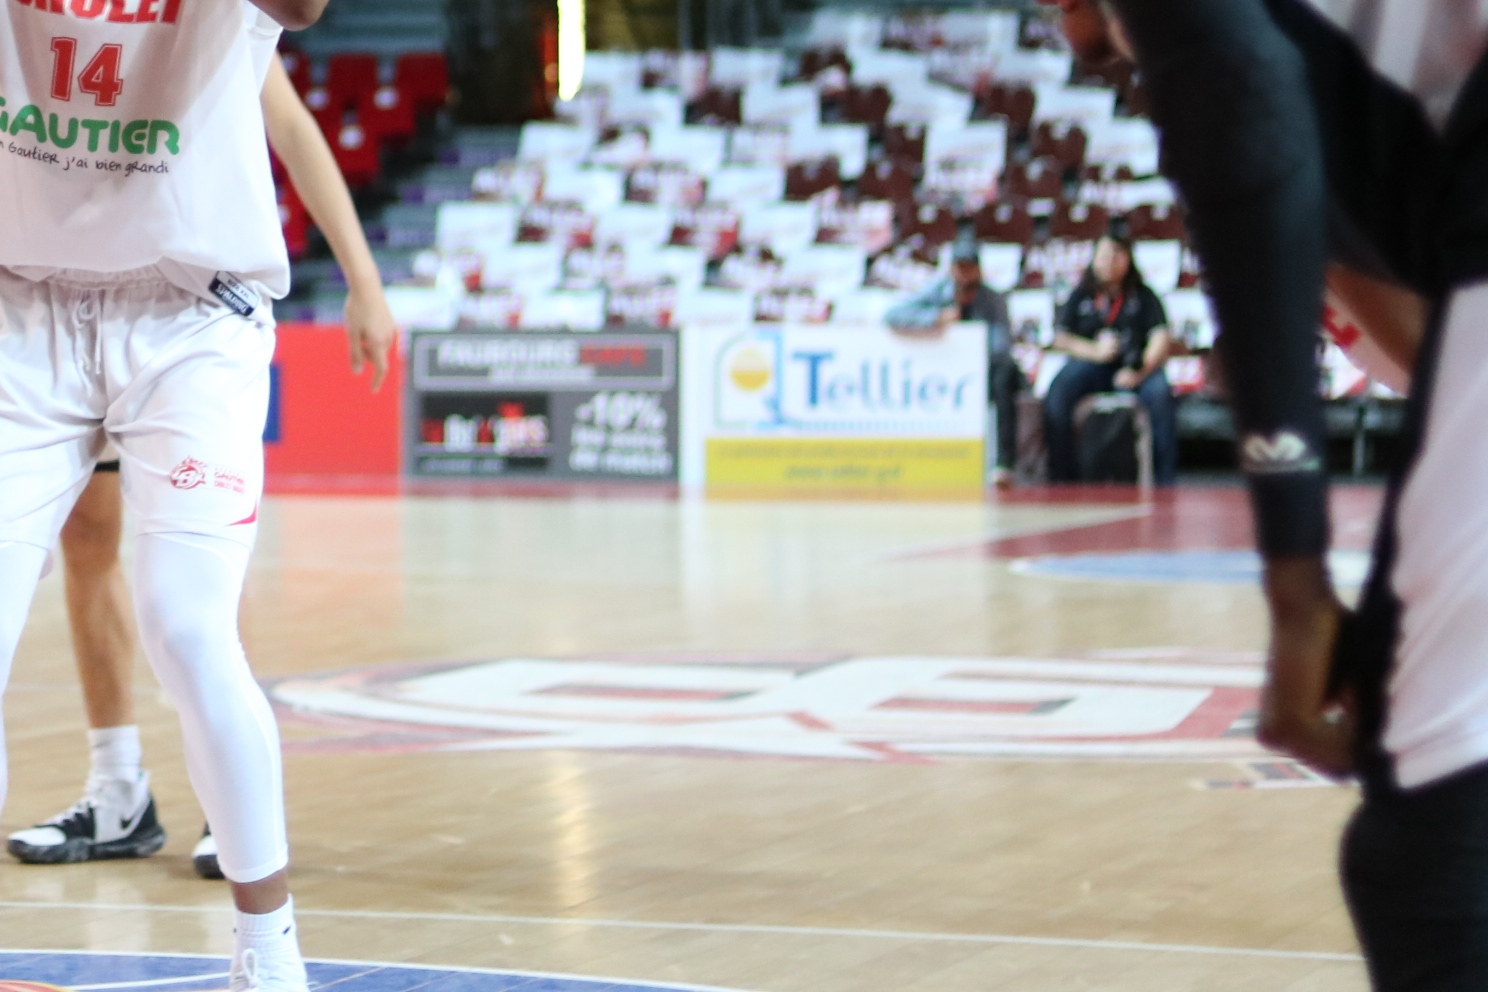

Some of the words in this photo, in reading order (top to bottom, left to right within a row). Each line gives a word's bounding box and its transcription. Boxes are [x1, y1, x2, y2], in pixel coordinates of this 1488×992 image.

[50, 35, 124, 107] 14
[62, 157, 89, 172] j'ai
[791, 349, 975, 412] Tellier
[574, 391, 668, 430] -10%
